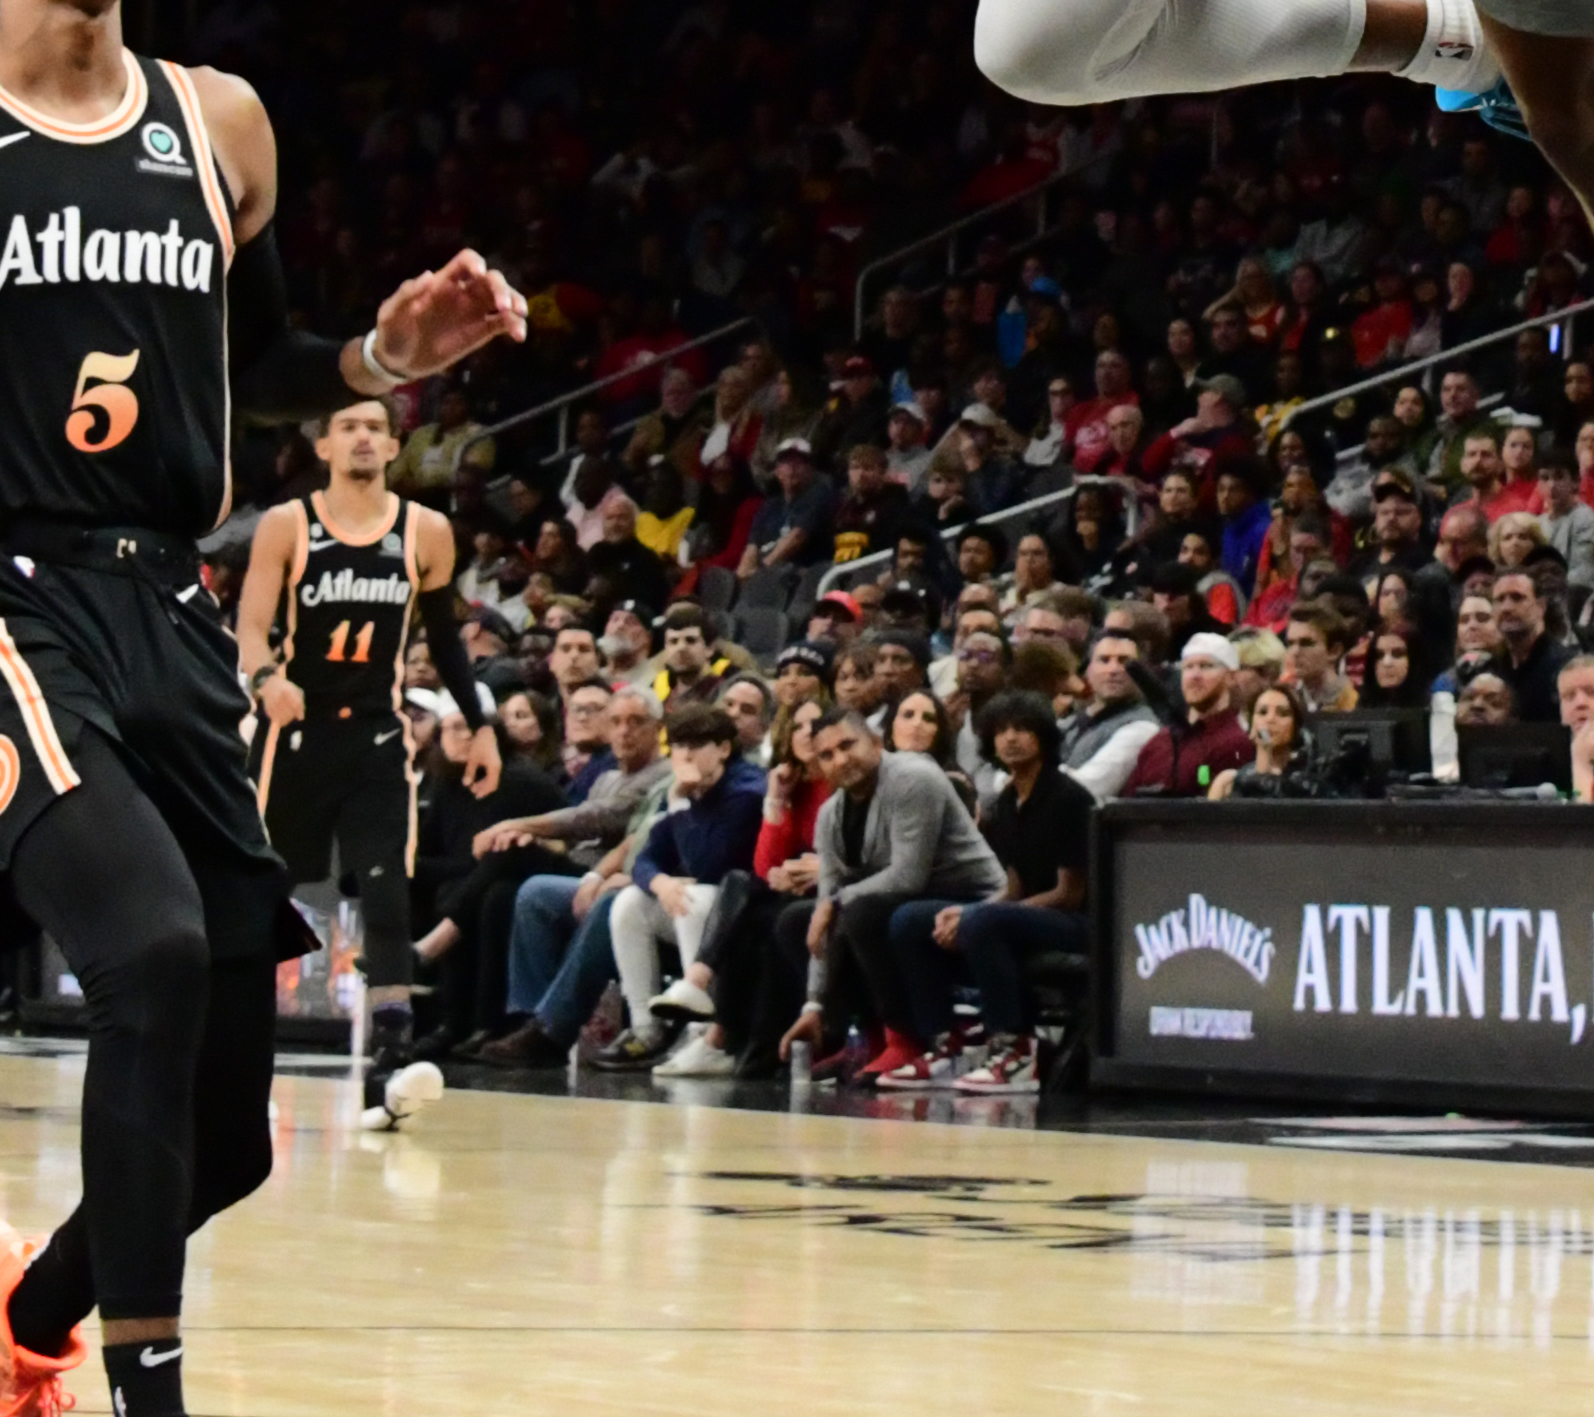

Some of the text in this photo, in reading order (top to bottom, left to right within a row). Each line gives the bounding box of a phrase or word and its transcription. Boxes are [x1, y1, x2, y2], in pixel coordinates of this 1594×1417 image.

[65, 348, 141, 454] 5
[301, 568, 412, 607] Atlanta
[325, 619, 375, 662] 11
[1135, 909, 1190, 980] JACK
[1292, 902, 1586, 1046] ATLANTA,
